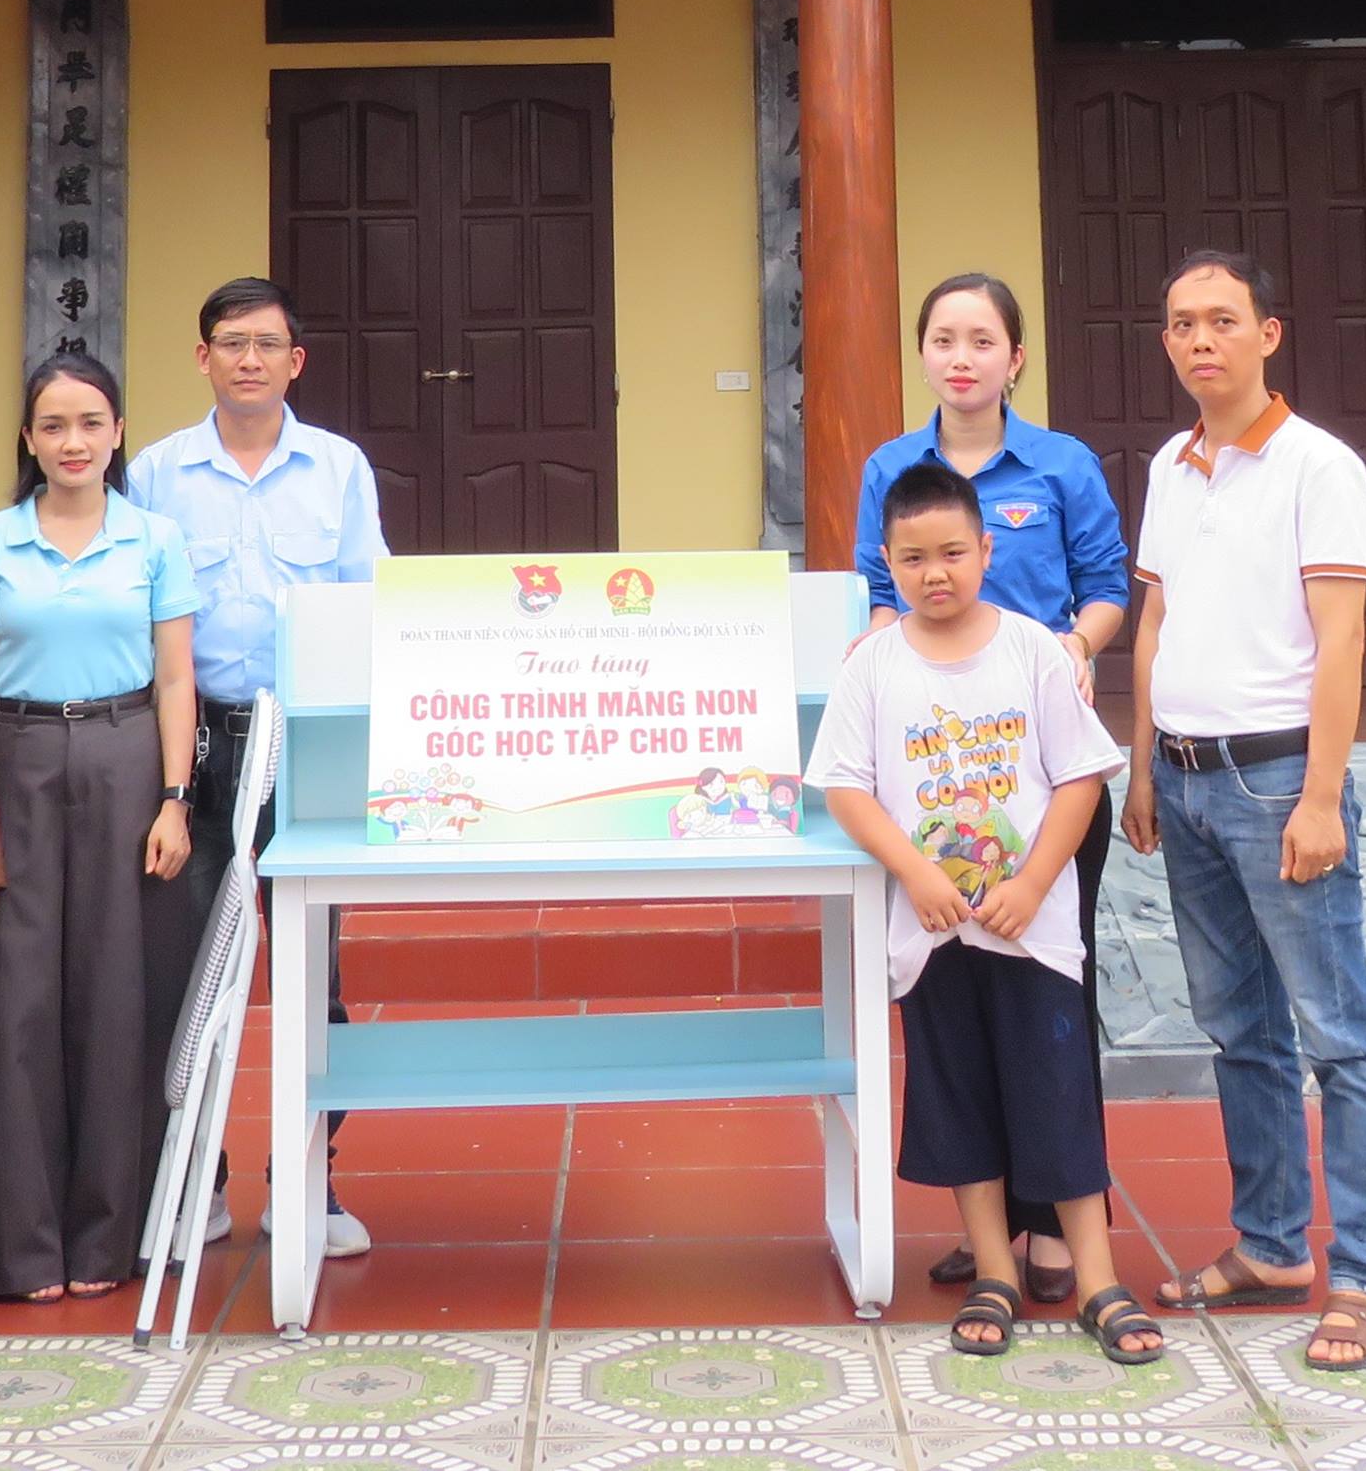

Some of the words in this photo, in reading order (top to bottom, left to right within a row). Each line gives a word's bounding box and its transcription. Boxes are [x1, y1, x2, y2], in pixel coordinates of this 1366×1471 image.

[400, 627, 432, 642] ĐOÀN
[434, 629, 473, 641] THANH
[474, 626, 501, 640] NIÊN
[502, 627, 533, 642] CỘNG
[600, 626, 630, 639] MINH
[515, 650, 580, 675] Trao
[591, 654, 651, 678] tặng
[410, 689, 491, 721] CÔNG
[501, 687, 587, 719] TRÌNH
[598, 685, 685, 718] MĂNG
[696, 689, 758, 717] NON
[426, 726, 484, 758] GÓC
[496, 729, 554, 763] HỌC
[564, 723, 619, 762] TẬP
[630, 727, 688, 755] CHO
[698, 726, 743, 754] EM
[905, 723, 949, 762] ĂN
[956, 707, 1026, 749] CHƠI
